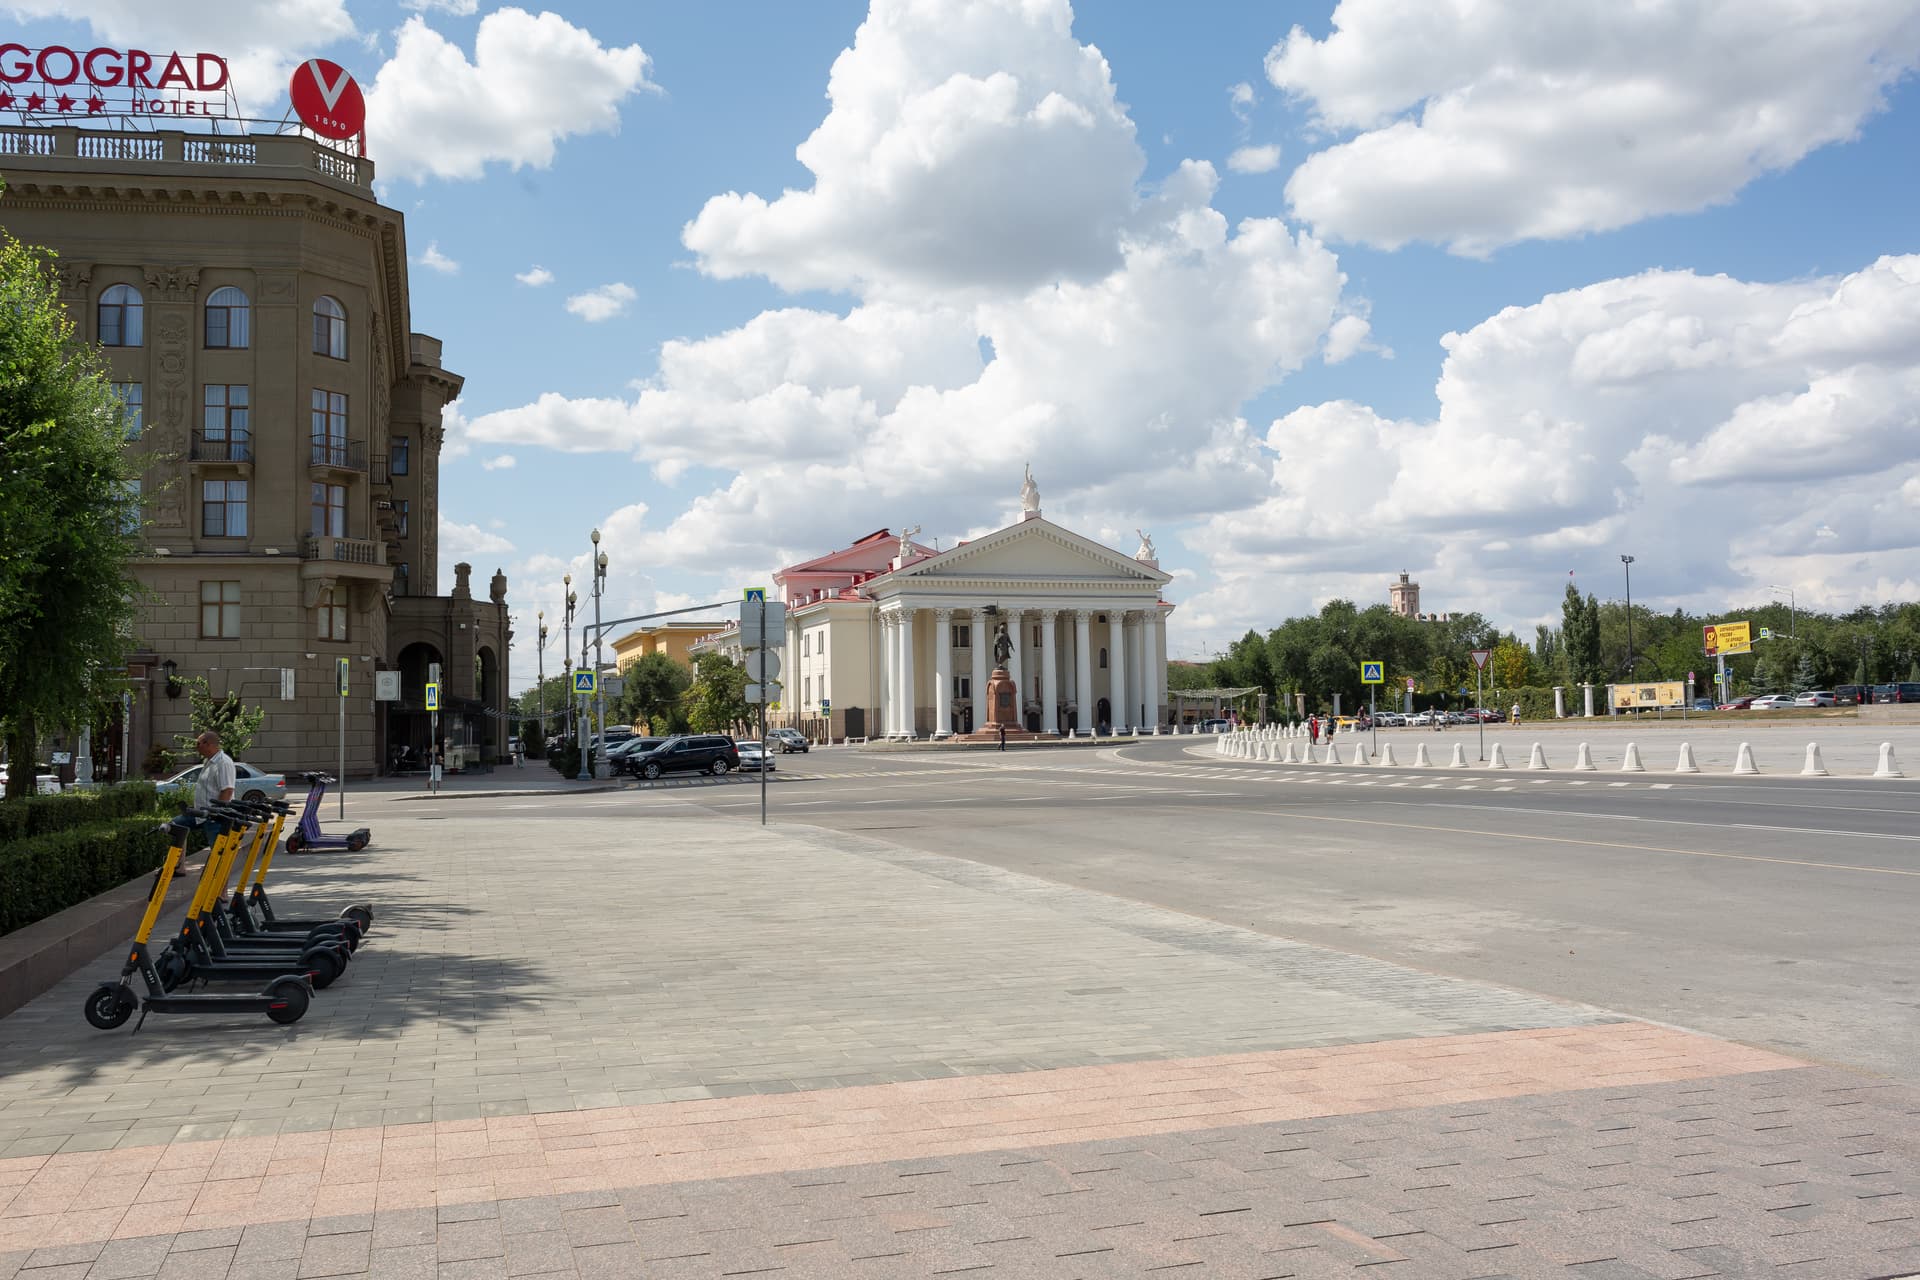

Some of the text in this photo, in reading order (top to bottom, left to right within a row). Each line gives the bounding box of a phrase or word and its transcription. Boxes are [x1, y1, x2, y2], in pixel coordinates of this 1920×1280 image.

[0, 43, 229, 91] GOGRAD
[308, 59, 350, 112] V
[131, 98, 210, 115] HOTEL
[314, 114, 346, 130] 1890
